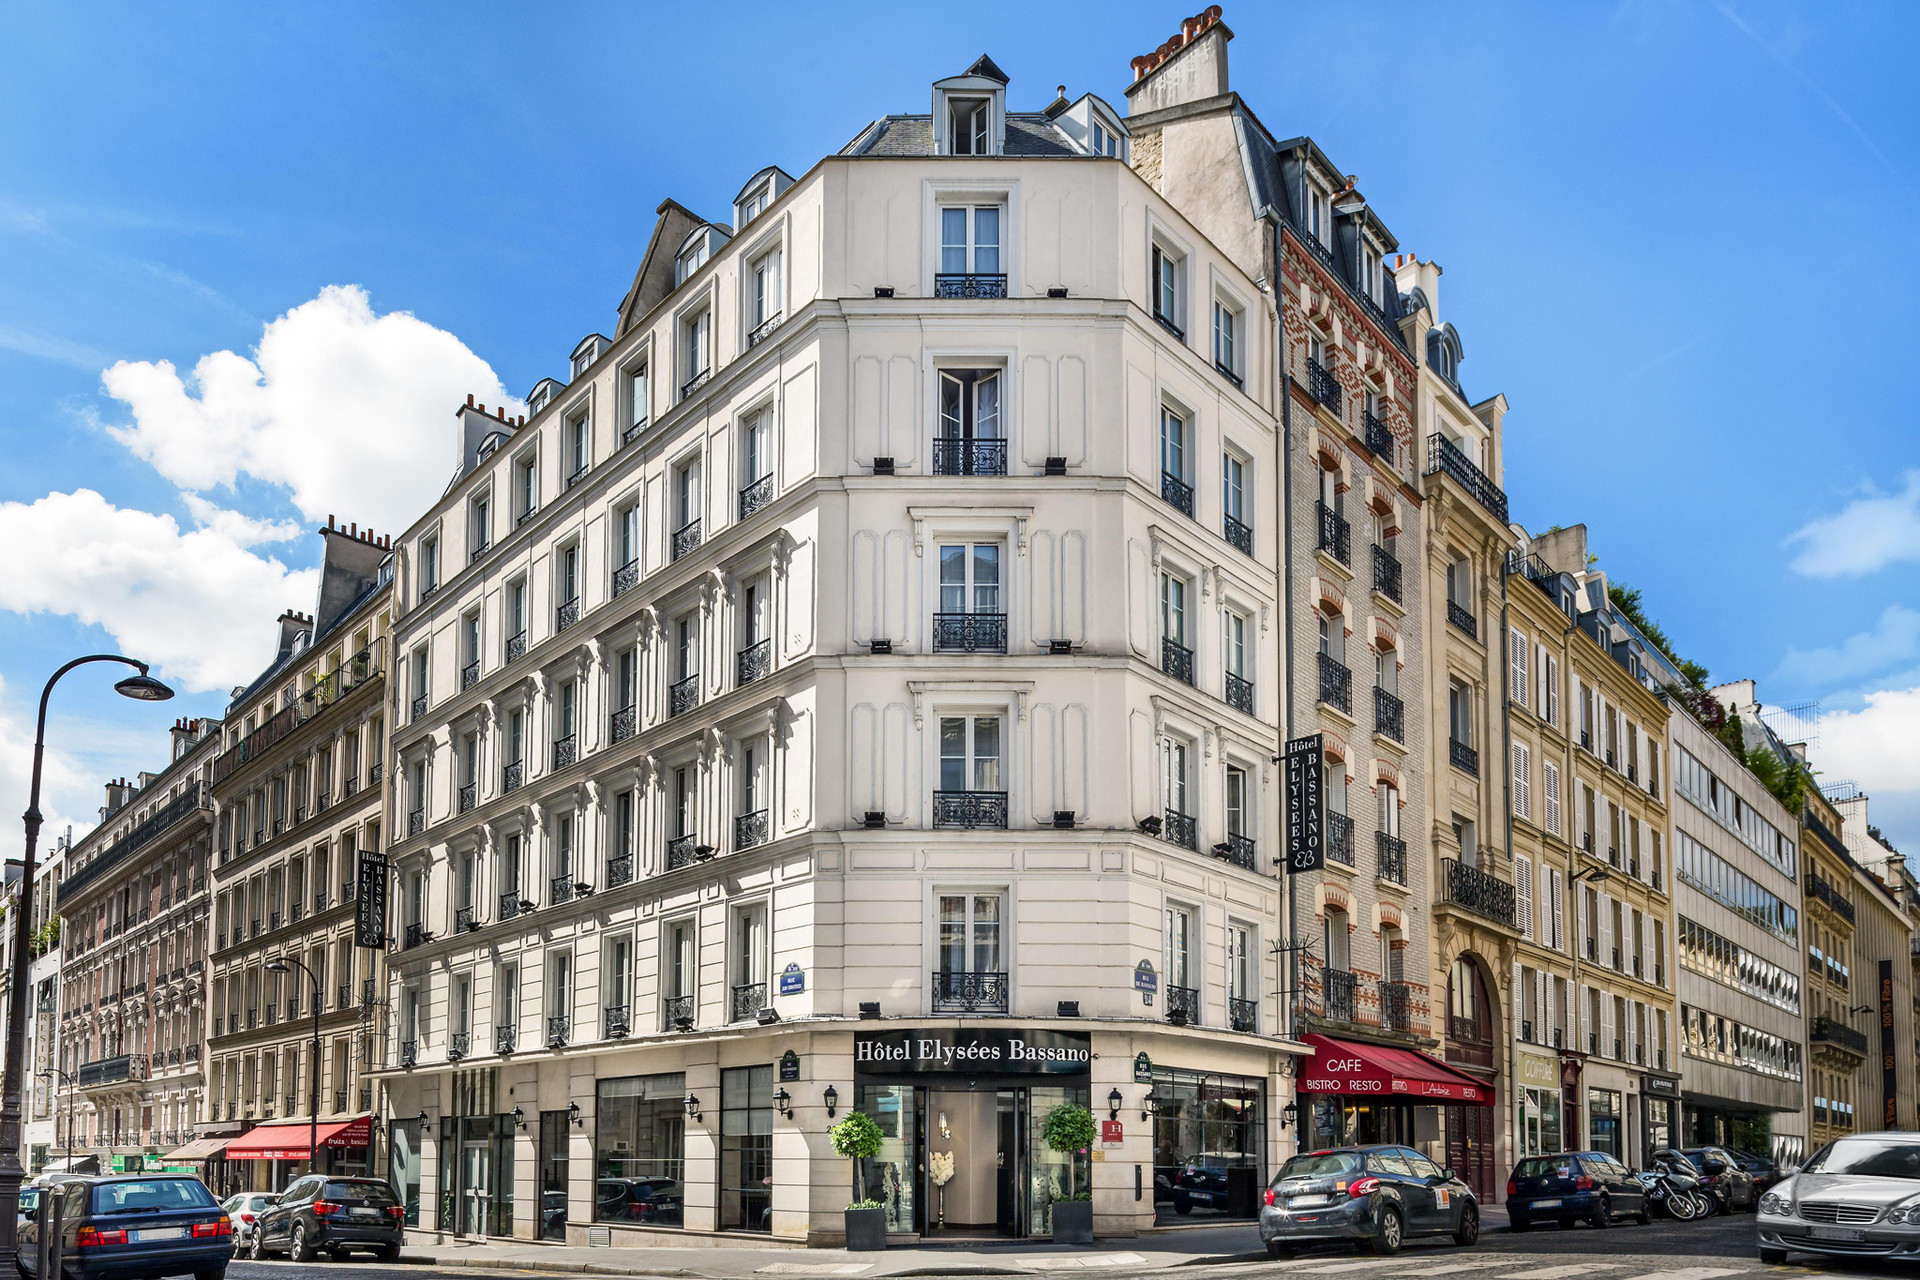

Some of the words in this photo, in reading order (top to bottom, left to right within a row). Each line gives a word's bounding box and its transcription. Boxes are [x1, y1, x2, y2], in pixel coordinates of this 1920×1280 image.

[1289, 737, 1318, 754] Hôtel
[1291, 756, 1300, 851] ELYSEES
[1308, 753, 1318, 848] BASSANO
[362, 852, 385, 863] Hôtel
[361, 864, 370, 931] ELYSEES
[374, 866, 384, 934] BASSANO
[1882, 979, 1891, 1001] Fibre
[856, 1039, 911, 1062] Hôtel
[917, 1039, 1000, 1065] Elysées
[1008, 1039, 1089, 1062] Bassano
[1326, 1059, 1362, 1072] CAFE
[1524, 1060, 1553, 1081] COIFFURE
[1306, 1080, 1341, 1090] BISTRO
[1349, 1080, 1382, 1091] RESTO
[1392, 1080, 1407, 1091] BISTRO
[1421, 1082, 1450, 1095] L'Ardoise
[1463, 1087, 1476, 1098] RESTO
[1111, 1124, 1121, 1133] H
